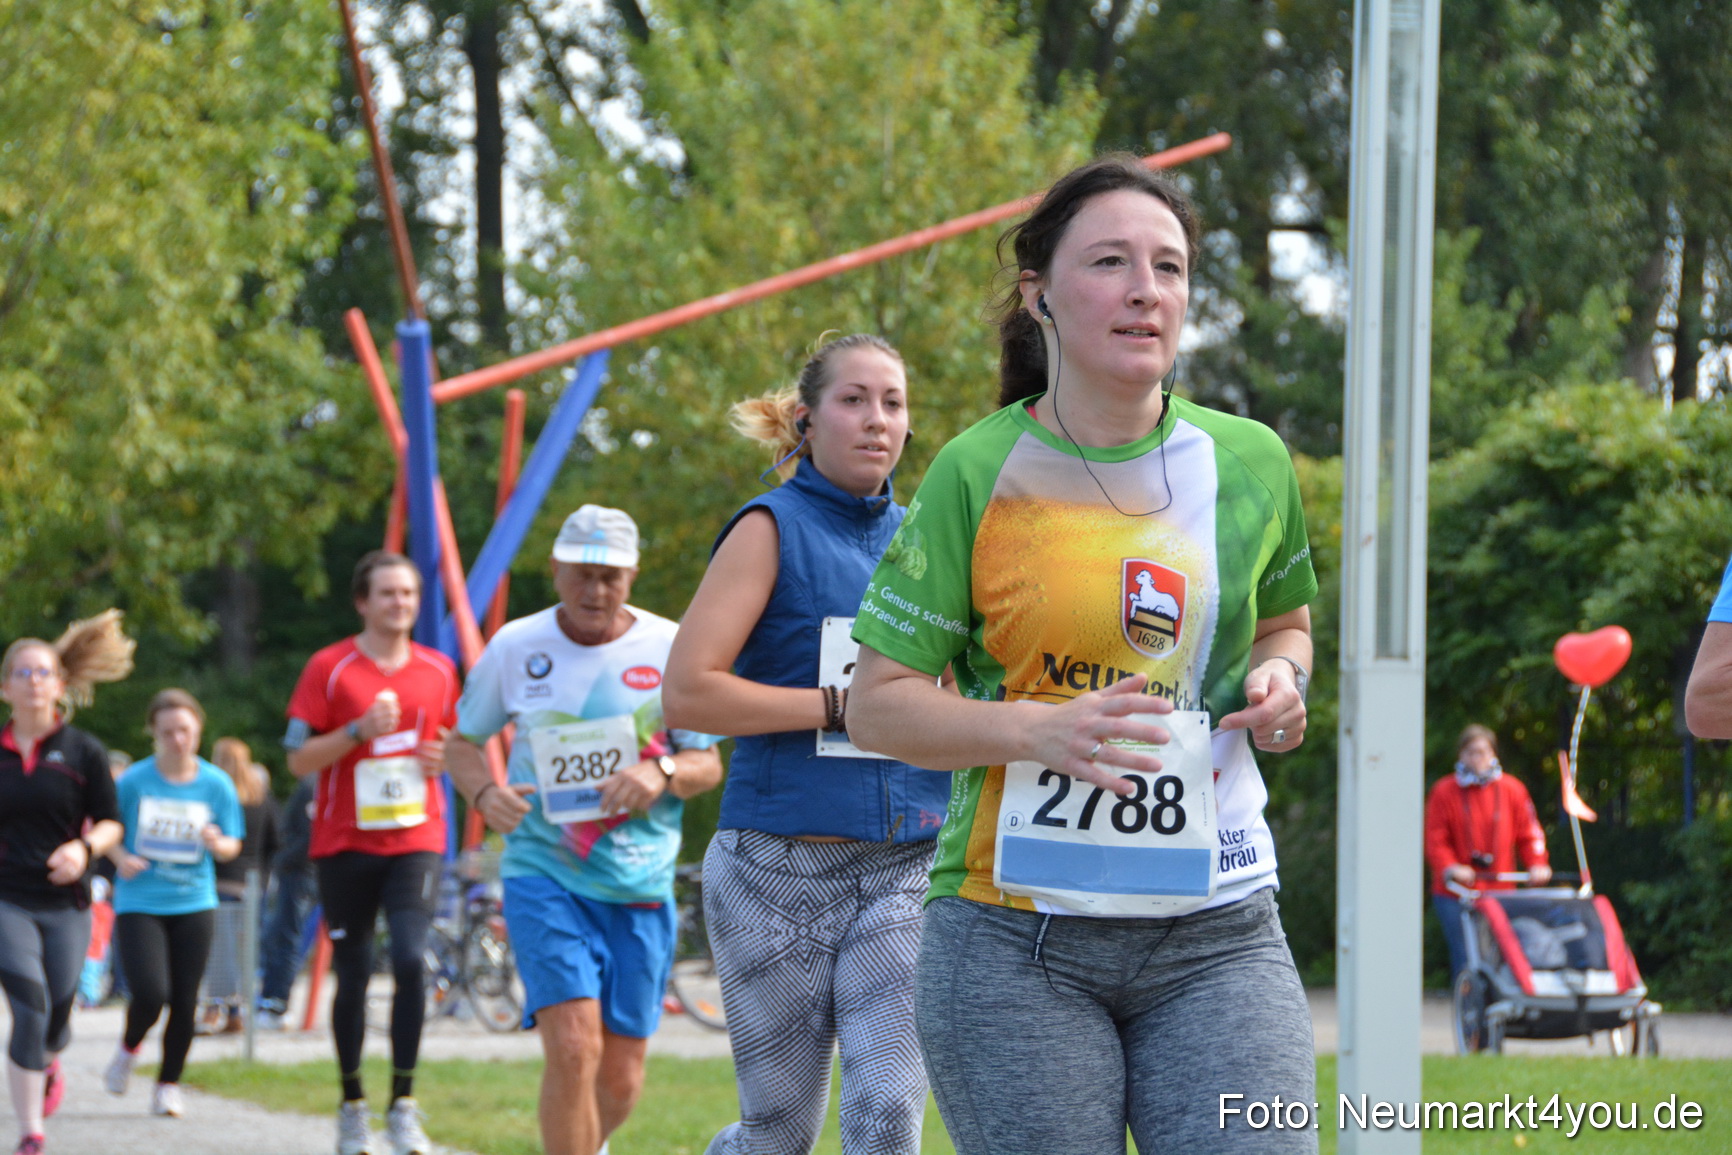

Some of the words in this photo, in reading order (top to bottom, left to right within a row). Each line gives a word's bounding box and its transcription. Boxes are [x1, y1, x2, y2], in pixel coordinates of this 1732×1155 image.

[880, 586, 921, 617] Genuss
[921, 610, 970, 637] schaffen.
[1135, 630, 1166, 651] 1628
[551, 747, 622, 784] 2382
[1031, 767, 1187, 836] 2788
[1217, 845, 1258, 873] bräu
